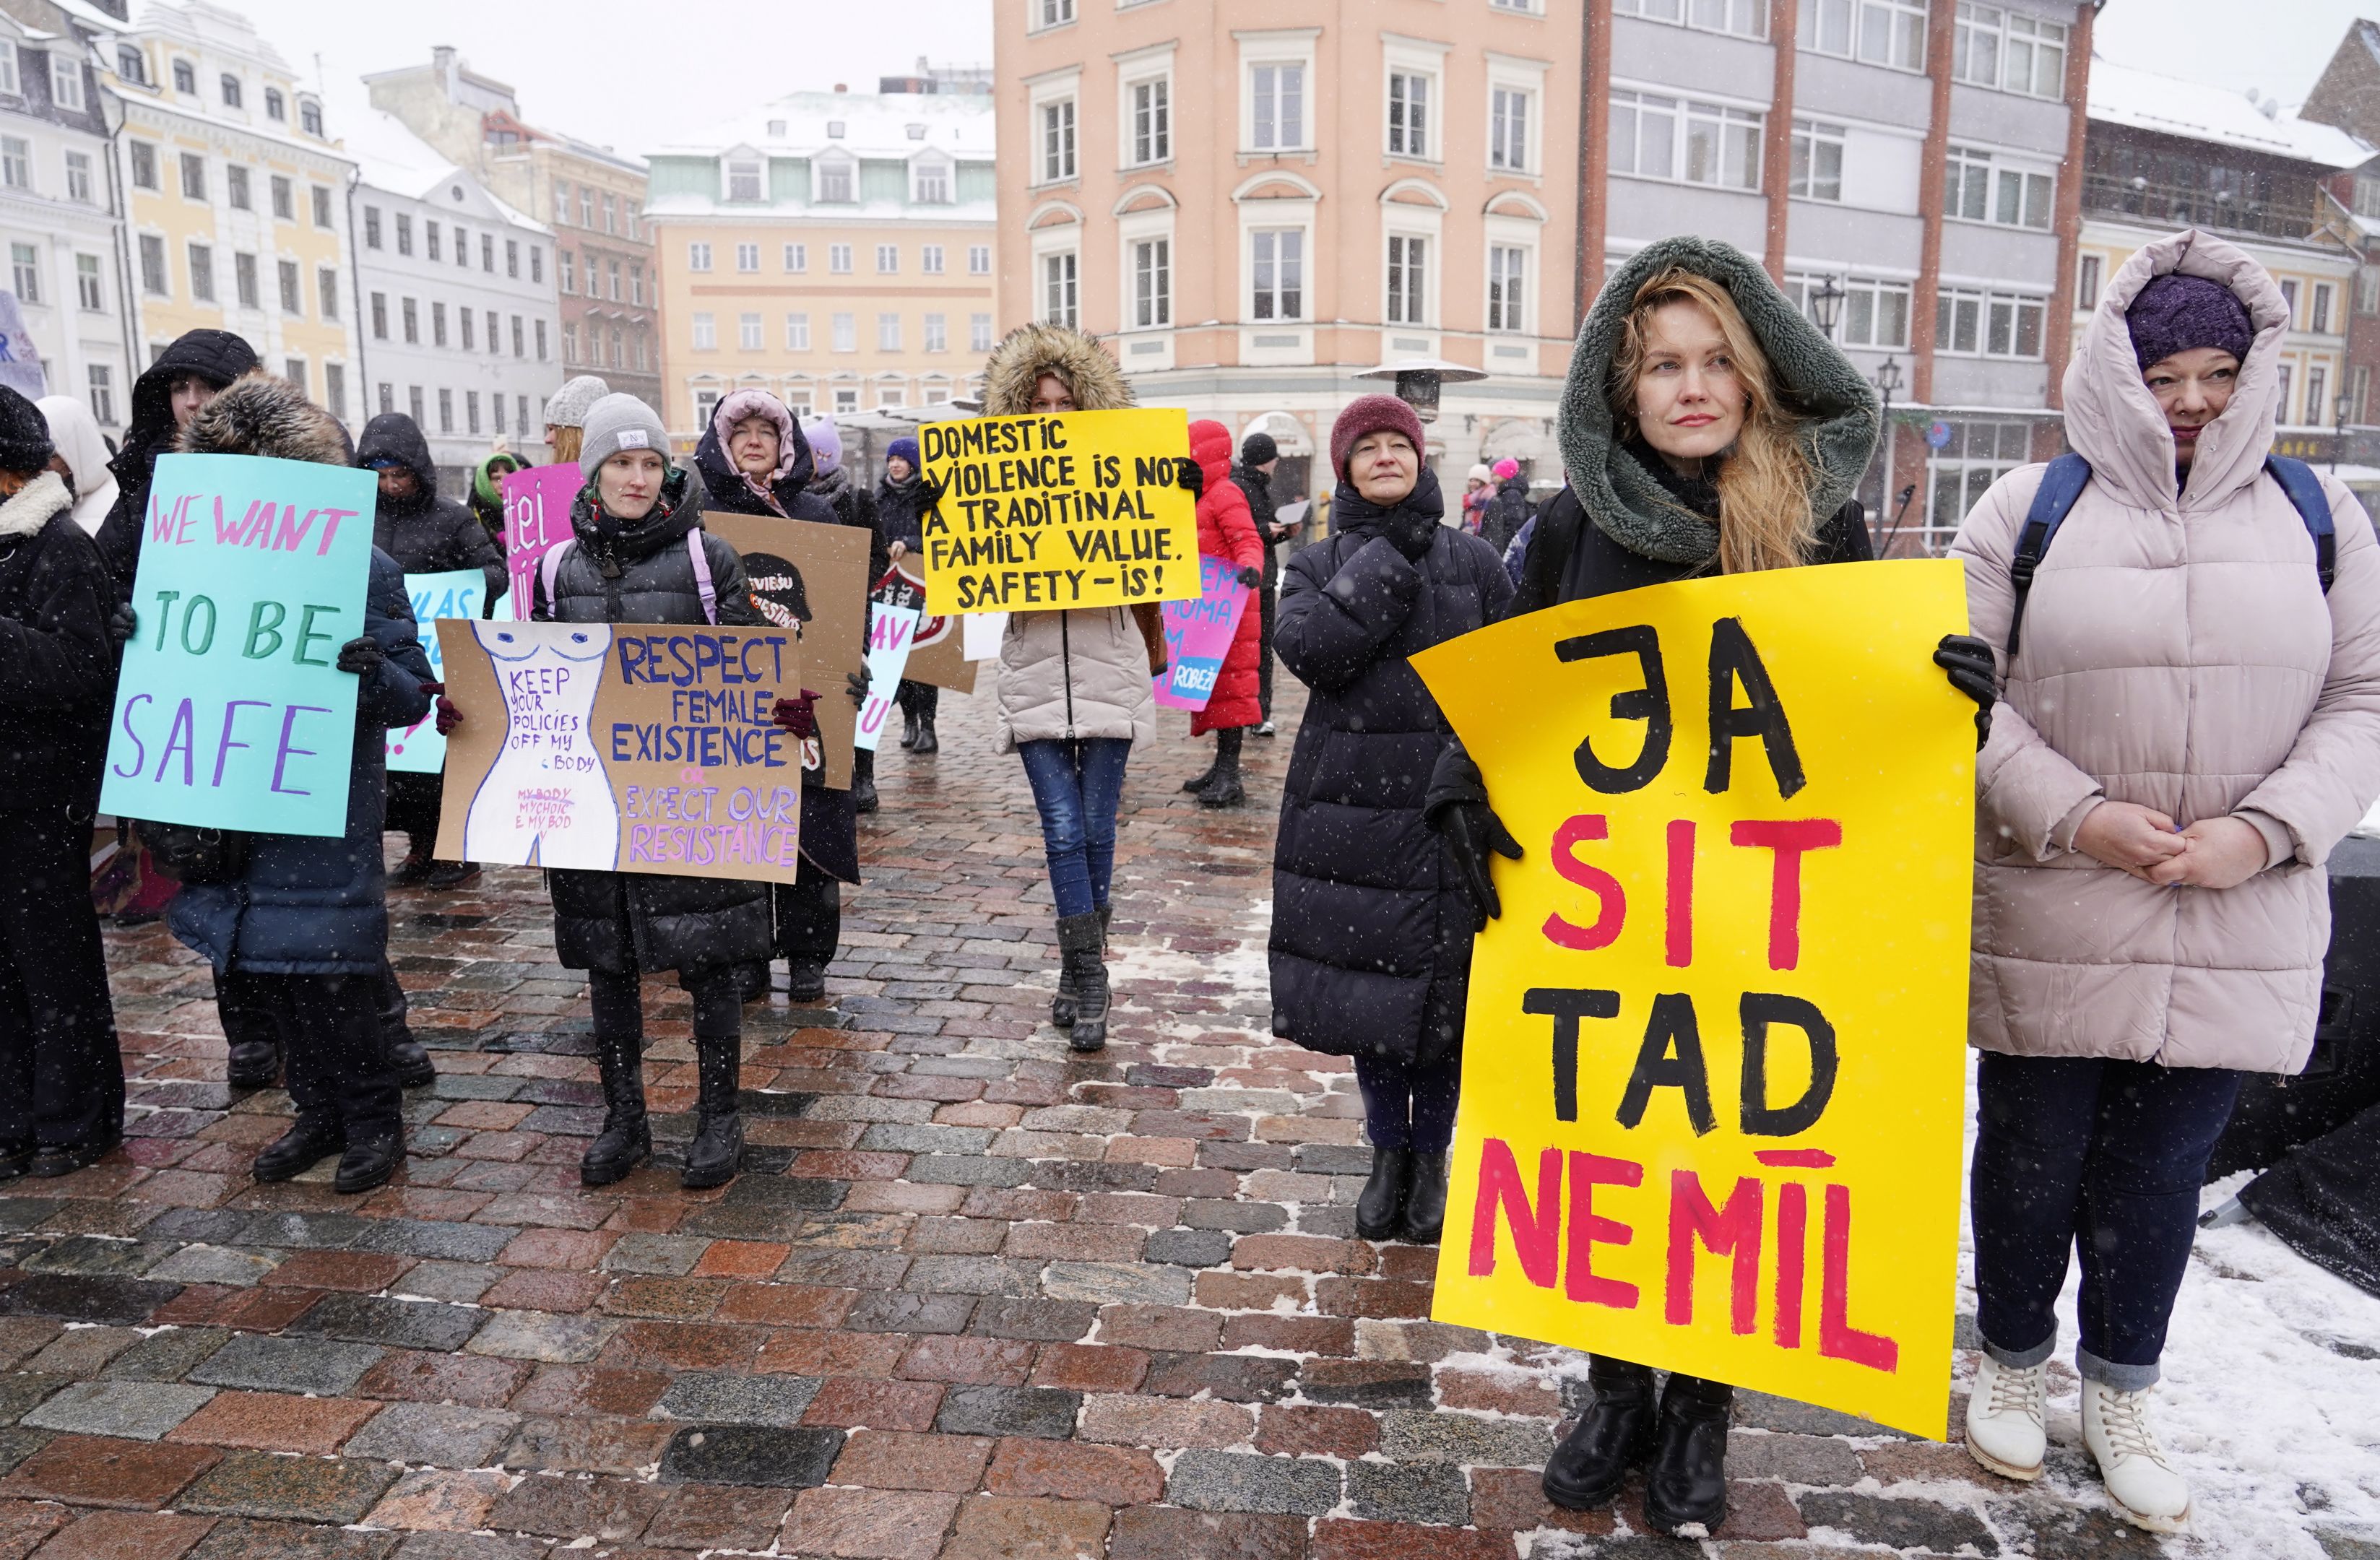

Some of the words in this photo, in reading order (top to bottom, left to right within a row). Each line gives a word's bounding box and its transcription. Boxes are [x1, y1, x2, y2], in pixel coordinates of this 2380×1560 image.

[152, 494, 203, 545] WE
[214, 495, 360, 556] WANT
[925, 507, 950, 537] A
[1066, 528, 1182, 563] VALUE.
[156, 591, 216, 655] TO
[242, 601, 341, 667] BE
[618, 633, 787, 688] RESPECT
[510, 667, 570, 697] KEEP
[511, 694, 544, 714] YOUR
[672, 690, 774, 727] FEMALE
[113, 693, 333, 795] SAFE
[511, 733, 542, 750] OFF
[551, 734, 573, 752] MY
[612, 723, 787, 768] EXISTENCE
[554, 755, 596, 774] BODY
[681, 766, 706, 785] OR
[518, 788, 534, 800] MY
[537, 787, 571, 802] BODY
[627, 786, 719, 822] EXPECT
[728, 785, 797, 824] OUR
[516, 815, 524, 829] E
[529, 815, 545, 829] MY
[548, 815, 571, 828] BOD
[540, 831, 547, 844] Y
[629, 822, 798, 867] RESISTANCE
[1541, 812, 1843, 971] SIT
[1521, 987, 1840, 1139] TAD
[1468, 1137, 1900, 1375] NEMĪL
